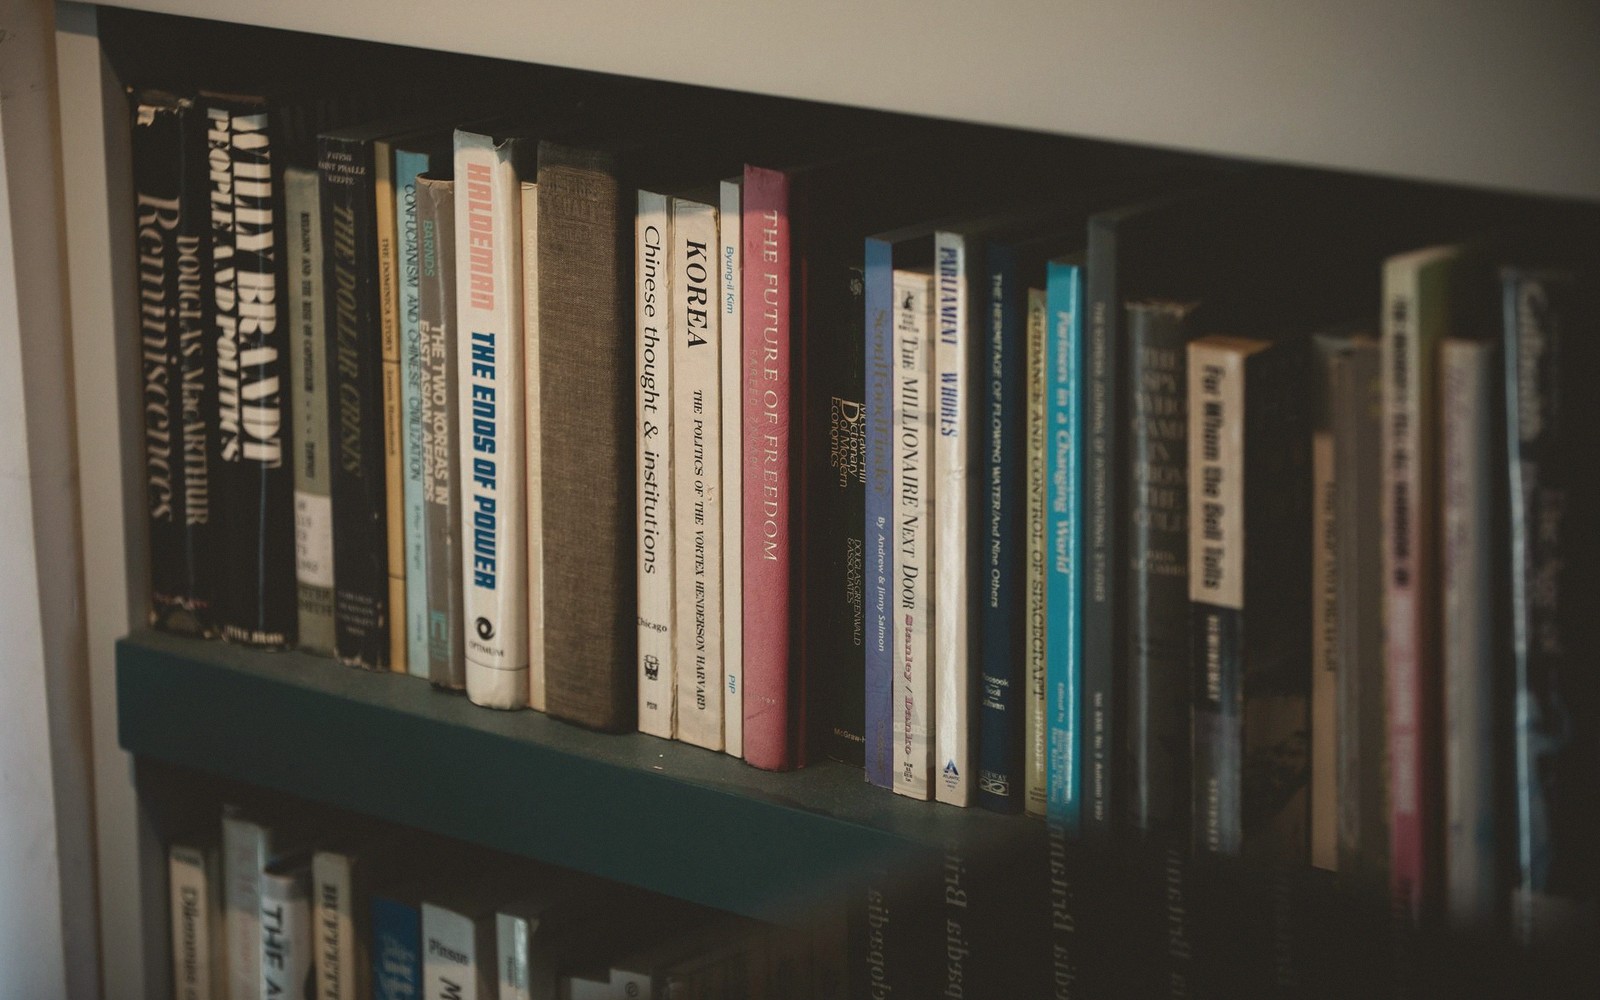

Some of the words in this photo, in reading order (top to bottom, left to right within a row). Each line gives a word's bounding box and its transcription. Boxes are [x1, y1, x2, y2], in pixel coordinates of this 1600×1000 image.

[207, 107, 234, 233] PEOPLE
[230, 113, 275, 262] WILLY
[334, 203, 358, 265] THE
[404, 184, 419, 288] CONFUCIANISM
[423, 219, 437, 277] BARNDS
[467, 162, 495, 312] HALDEMAN
[763, 211, 778, 263] THE
[176, 235, 204, 357] DOUGLAS
[212, 236, 236, 312] AND
[643, 225, 661, 318] Chinese
[686, 237, 708, 348] KOREA
[724, 245, 736, 290] Byung-il
[941, 246, 958, 346] PARLIAMENT
[992, 273, 1003, 299] THE
[335, 264, 361, 379] DOLLAR
[407, 294, 420, 323] AND
[726, 293, 736, 315] Kim
[763, 272, 779, 382] FUTURE
[136, 192, 181, 522] Reminiscences
[236, 270, 283, 468] BRANDT
[407, 328, 421, 390] CHINESE
[419, 320, 431, 362] EAST
[430, 323, 447, 360] THE
[471, 331, 496, 381] THE
[640, 326, 661, 413] thought
[902, 336, 919, 369] THE
[992, 302, 1003, 380] HERMITAGE
[1055, 310, 1073, 383] Partners
[214, 313, 242, 464] POLITICS
[420, 369, 433, 422] ASIAN
[432, 364, 448, 406] TWO
[693, 390, 703, 415] THE
[748, 348, 758, 407] FAREED
[941, 371, 958, 438] WHORES
[992, 381, 1002, 402] OF
[1056, 387, 1070, 407] in
[1203, 364, 1226, 394] For
[339, 382, 363, 478] CRISIS
[472, 384, 497, 454] ENDS
[644, 421, 659, 440] &
[763, 389, 779, 425] OF
[831, 396, 843, 468] Economics
[840, 422, 852, 439] of
[992, 403, 1002, 463] FLOWING
[1032, 410, 1044, 451] AND
[1056, 411, 1068, 425] a
[1203, 400, 1226, 462] Whom
[180, 366, 210, 527] MacARTHUR
[408, 395, 423, 482] CIVILIZATION
[422, 427, 436, 502] AFFAIRS
[432, 411, 450, 481] KOREAS
[693, 419, 704, 477] POLITICS
[750, 415, 759, 479] ZAKARIA
[839, 442, 852, 488] Modern
[841, 399, 861, 478] Dictionary
[901, 376, 919, 508] MILLIONAIRE
[435, 485, 450, 506] IN
[473, 457, 497, 490] OF
[694, 479, 704, 496] OF
[763, 434, 779, 562] FREEDOM
[1031, 457, 1044, 545] CONTROL
[1054, 430, 1072, 514] Changing
[1203, 466, 1226, 498] the
[644, 450, 661, 574] institutions
[695, 500, 705, 525] THE
[876, 516, 886, 529] By
[902, 512, 919, 559] NEXT
[1203, 503, 1226, 541] Bell
[473, 495, 497, 591] POWER
[695, 529, 705, 577] VORTEX
[877, 534, 886, 573] Andrew
[991, 539, 1001, 567] Nine
[1031, 549, 1044, 576] OF
[1055, 519, 1070, 574] World
[1203, 546, 1226, 589] Tolls
[876, 586, 886, 613] Jinny
[877, 575, 886, 585] &
[902, 564, 919, 610] DOOR
[991, 568, 1001, 608] Others
[695, 580, 706, 652] HENDERSON
[877, 614, 887, 652] Salmon
[1031, 578, 1045, 701] SPACECRAFT
[904, 613, 914, 683] Stanley
[696, 654, 707, 711] HARVARD
[728, 673, 736, 695] PIP
[904, 695, 914, 756] Danko
